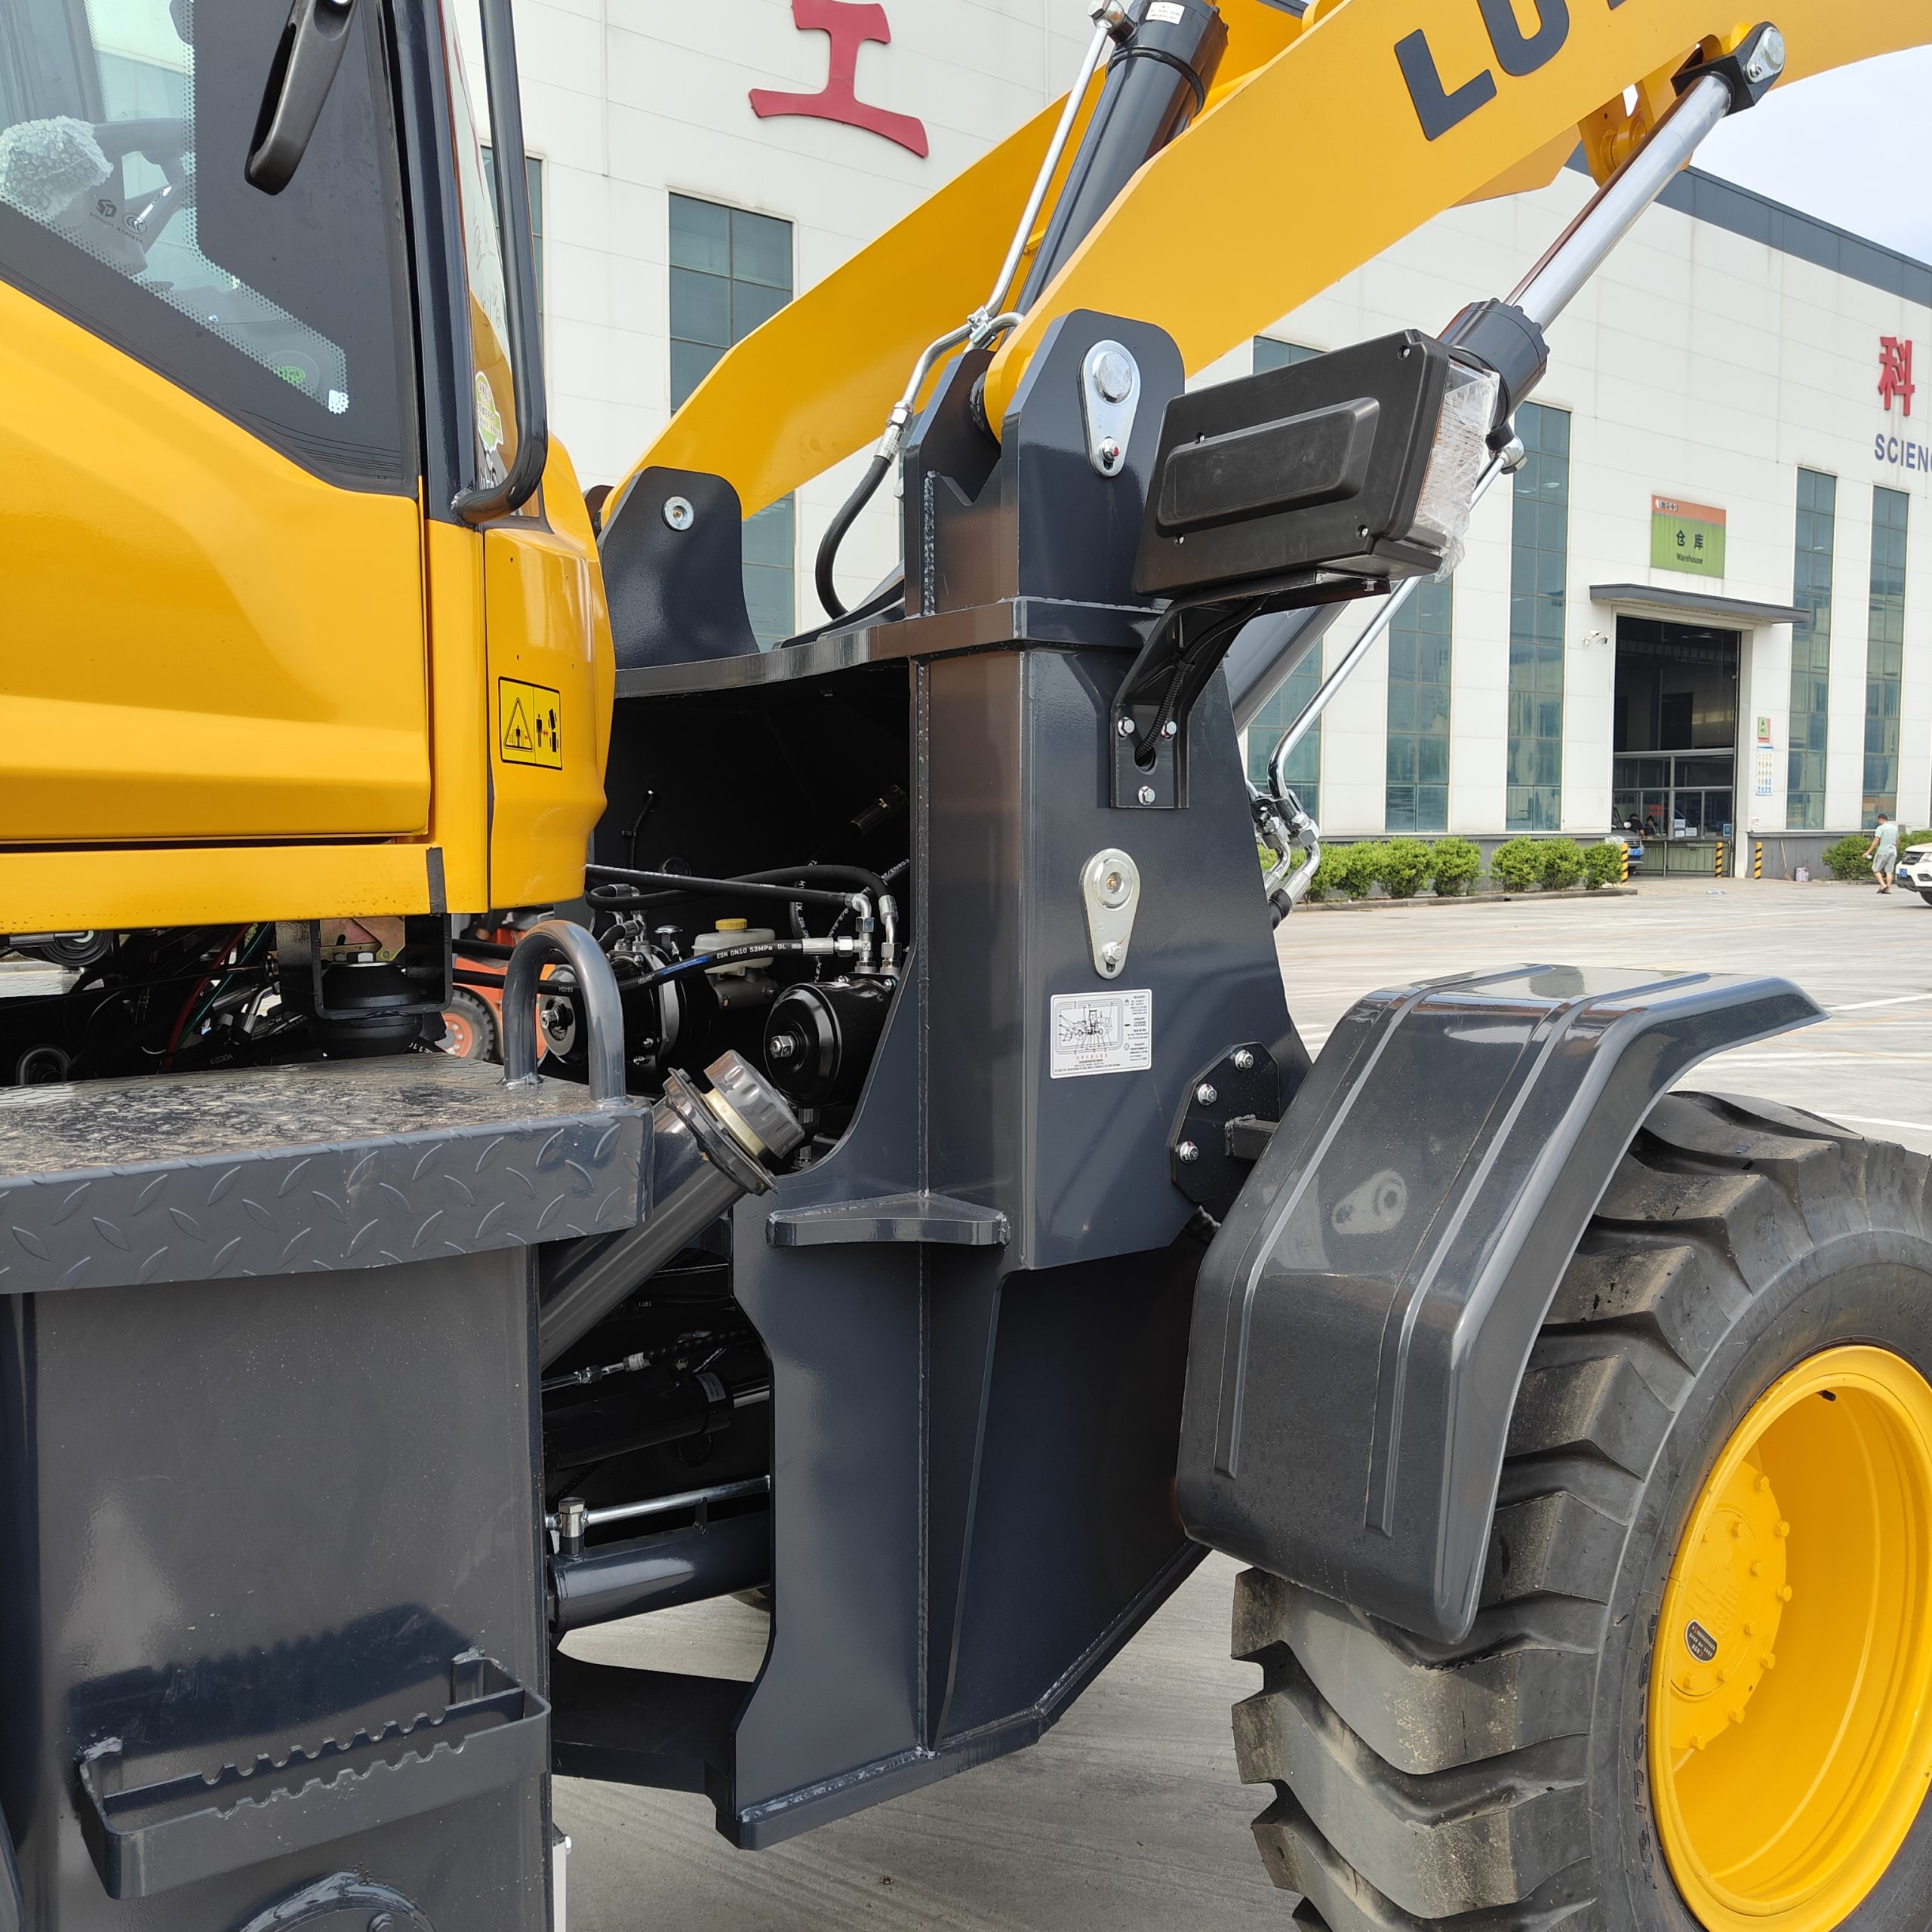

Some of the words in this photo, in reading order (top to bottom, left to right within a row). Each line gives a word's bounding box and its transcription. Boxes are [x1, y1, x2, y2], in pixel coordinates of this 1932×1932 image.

[748, 0, 929, 158] 工
[1394, 0, 1623, 141] LU
[1878, 336, 1915, 417] 科
[1875, 433, 1932, 473] SCIEN
[1675, 529, 1703, 549] 仓库
[1675, 552, 1703, 565] Warehouse
